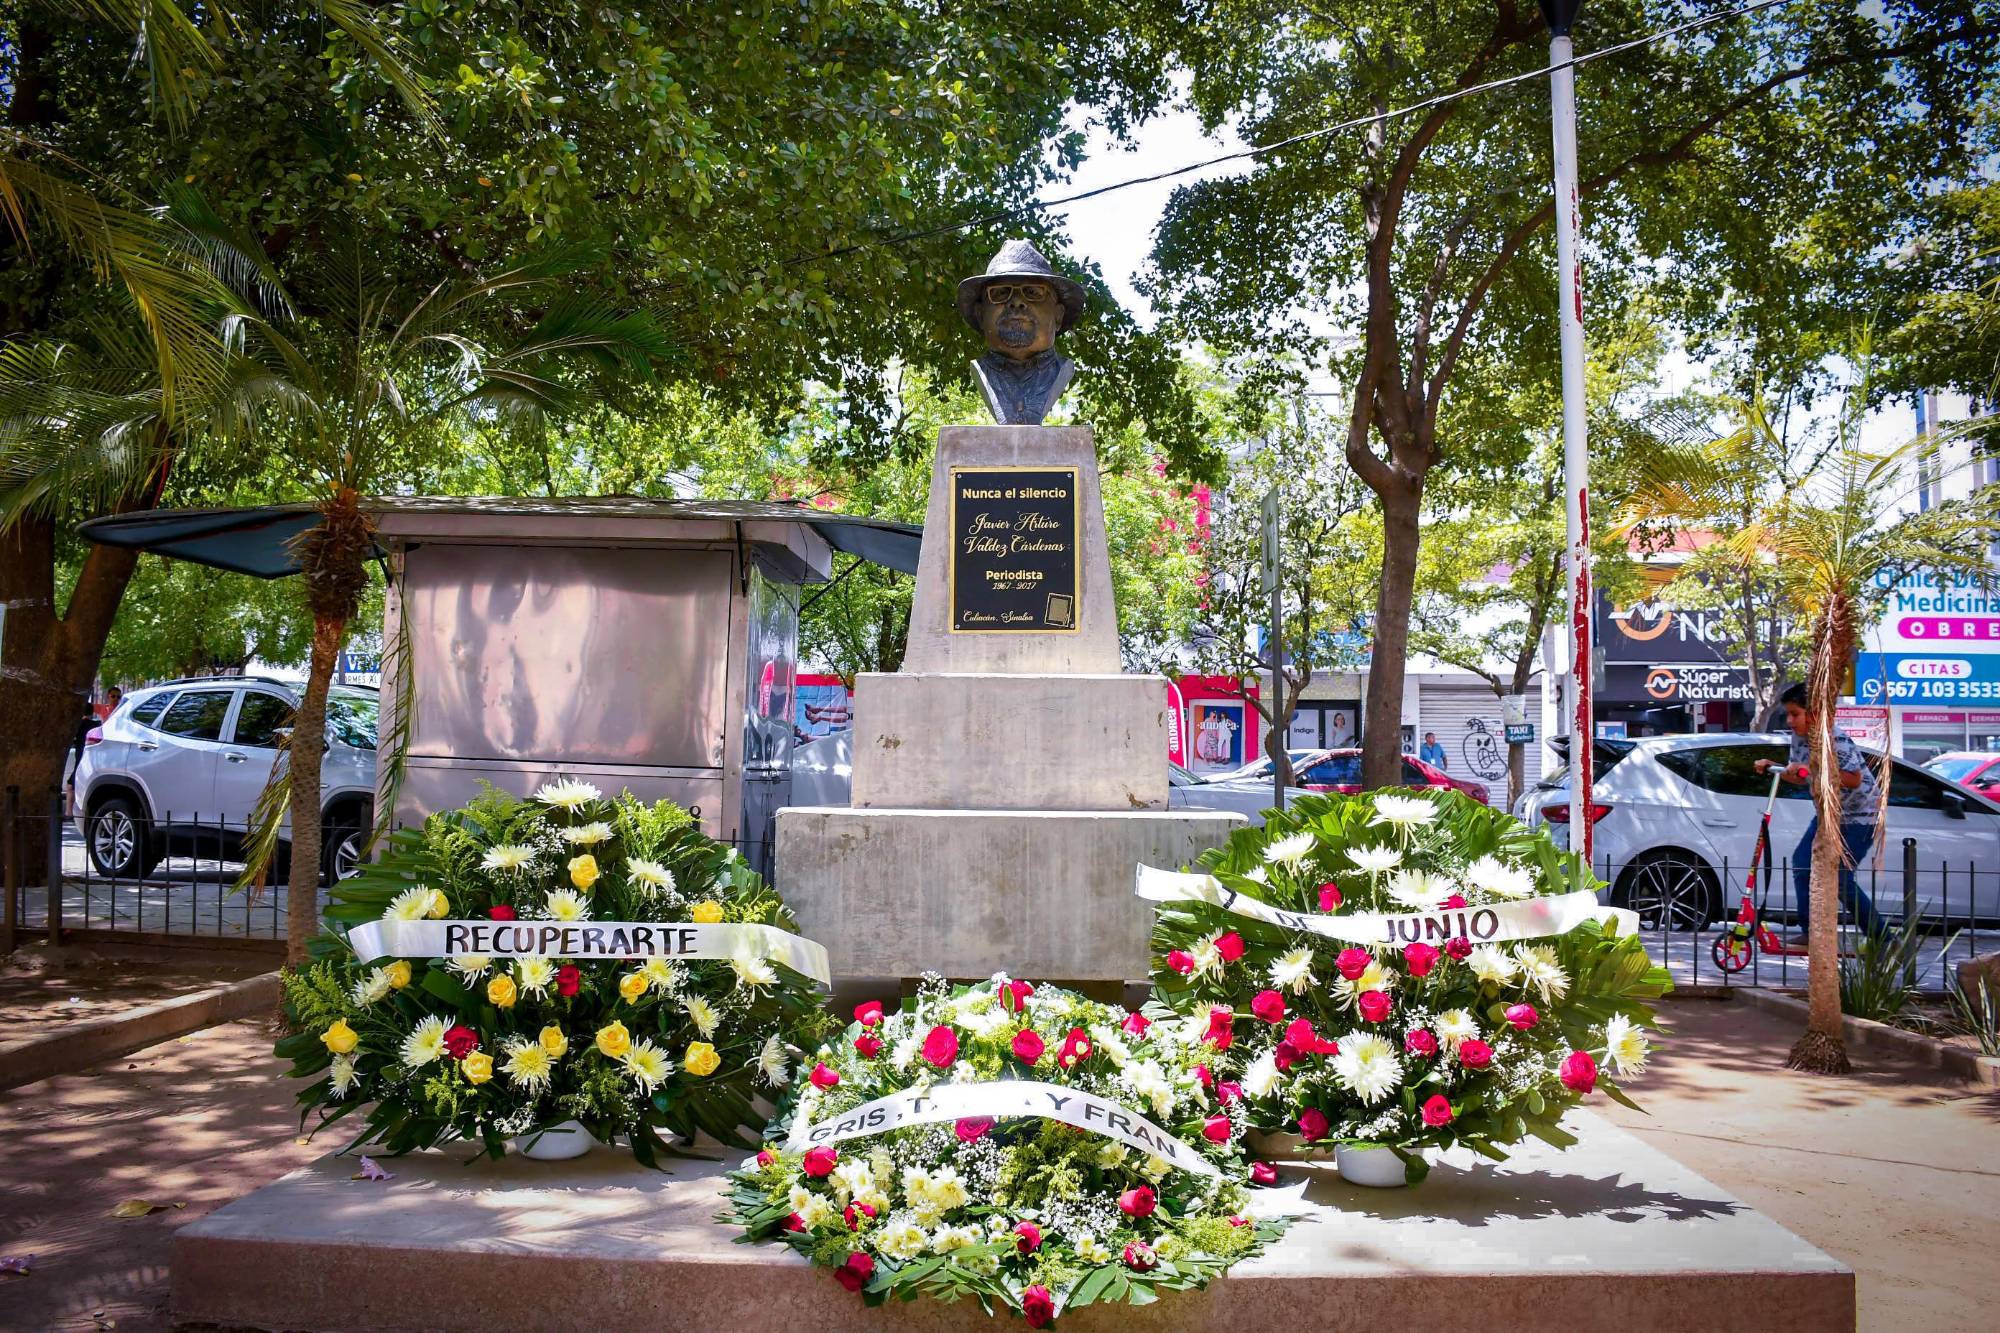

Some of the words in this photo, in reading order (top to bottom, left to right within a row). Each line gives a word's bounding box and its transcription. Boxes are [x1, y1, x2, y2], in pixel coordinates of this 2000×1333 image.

[962, 488, 1001, 499] Nunca
[1004, 487, 1016, 499] el
[1019, 487, 1067, 499] silencio
[969, 512, 1010, 534] Javier
[1013, 511, 1060, 532] Arturo
[963, 537, 1008, 558] Valdez
[1011, 534, 1065, 553] Cárdenas
[985, 570, 1043, 580] Periodista
[1898, 593, 2000, 612] Medicina
[1001, 611, 1034, 624] Sinaloa
[1678, 669, 1729, 686] Súper
[1908, 663, 1961, 675] CITAS
[1921, 681, 1955, 698] 103
[1914, 714, 1949, 722] FARMACIA
[1293, 727, 1315, 735] Indigo
[1507, 725, 1529, 735] TAXI
[1382, 908, 1499, 943] JUNIO
[445, 924, 698, 955] RECUPERARTE
[1046, 1092, 1073, 1111] Y
[1084, 1103, 1178, 1158] FRAN
